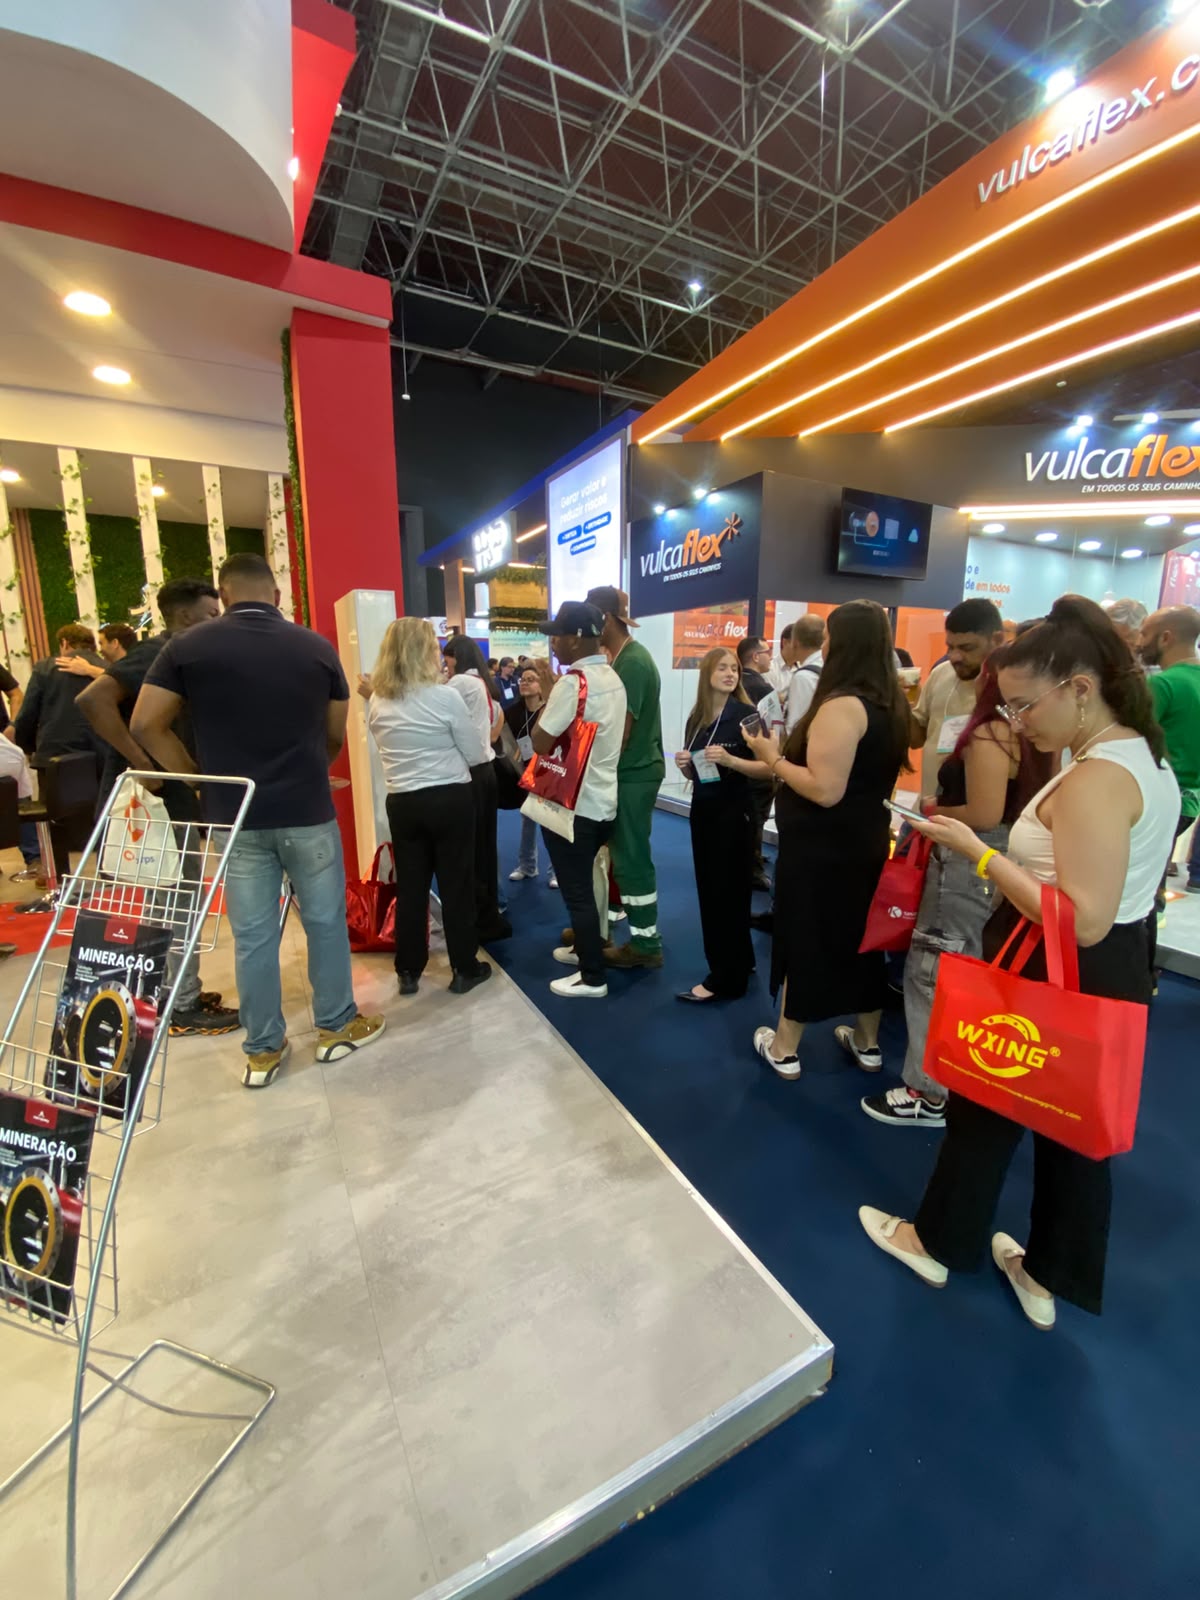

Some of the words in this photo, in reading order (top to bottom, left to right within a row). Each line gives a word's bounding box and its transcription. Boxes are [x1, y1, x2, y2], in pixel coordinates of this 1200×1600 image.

[1081, 484, 1095, 493] EM
[1096, 483, 1126, 492] TODOS
[1127, 483, 1140, 491] OS
[1141, 482, 1161, 491] SEUS
[640, 526, 724, 577] vulcaflex
[976, 582, 988, 591] em
[989, 582, 1011, 593] todos
[78, 946, 155, 973] MINERAÇÃO
[0, 1127, 77, 1162] MINERAÇÃO
